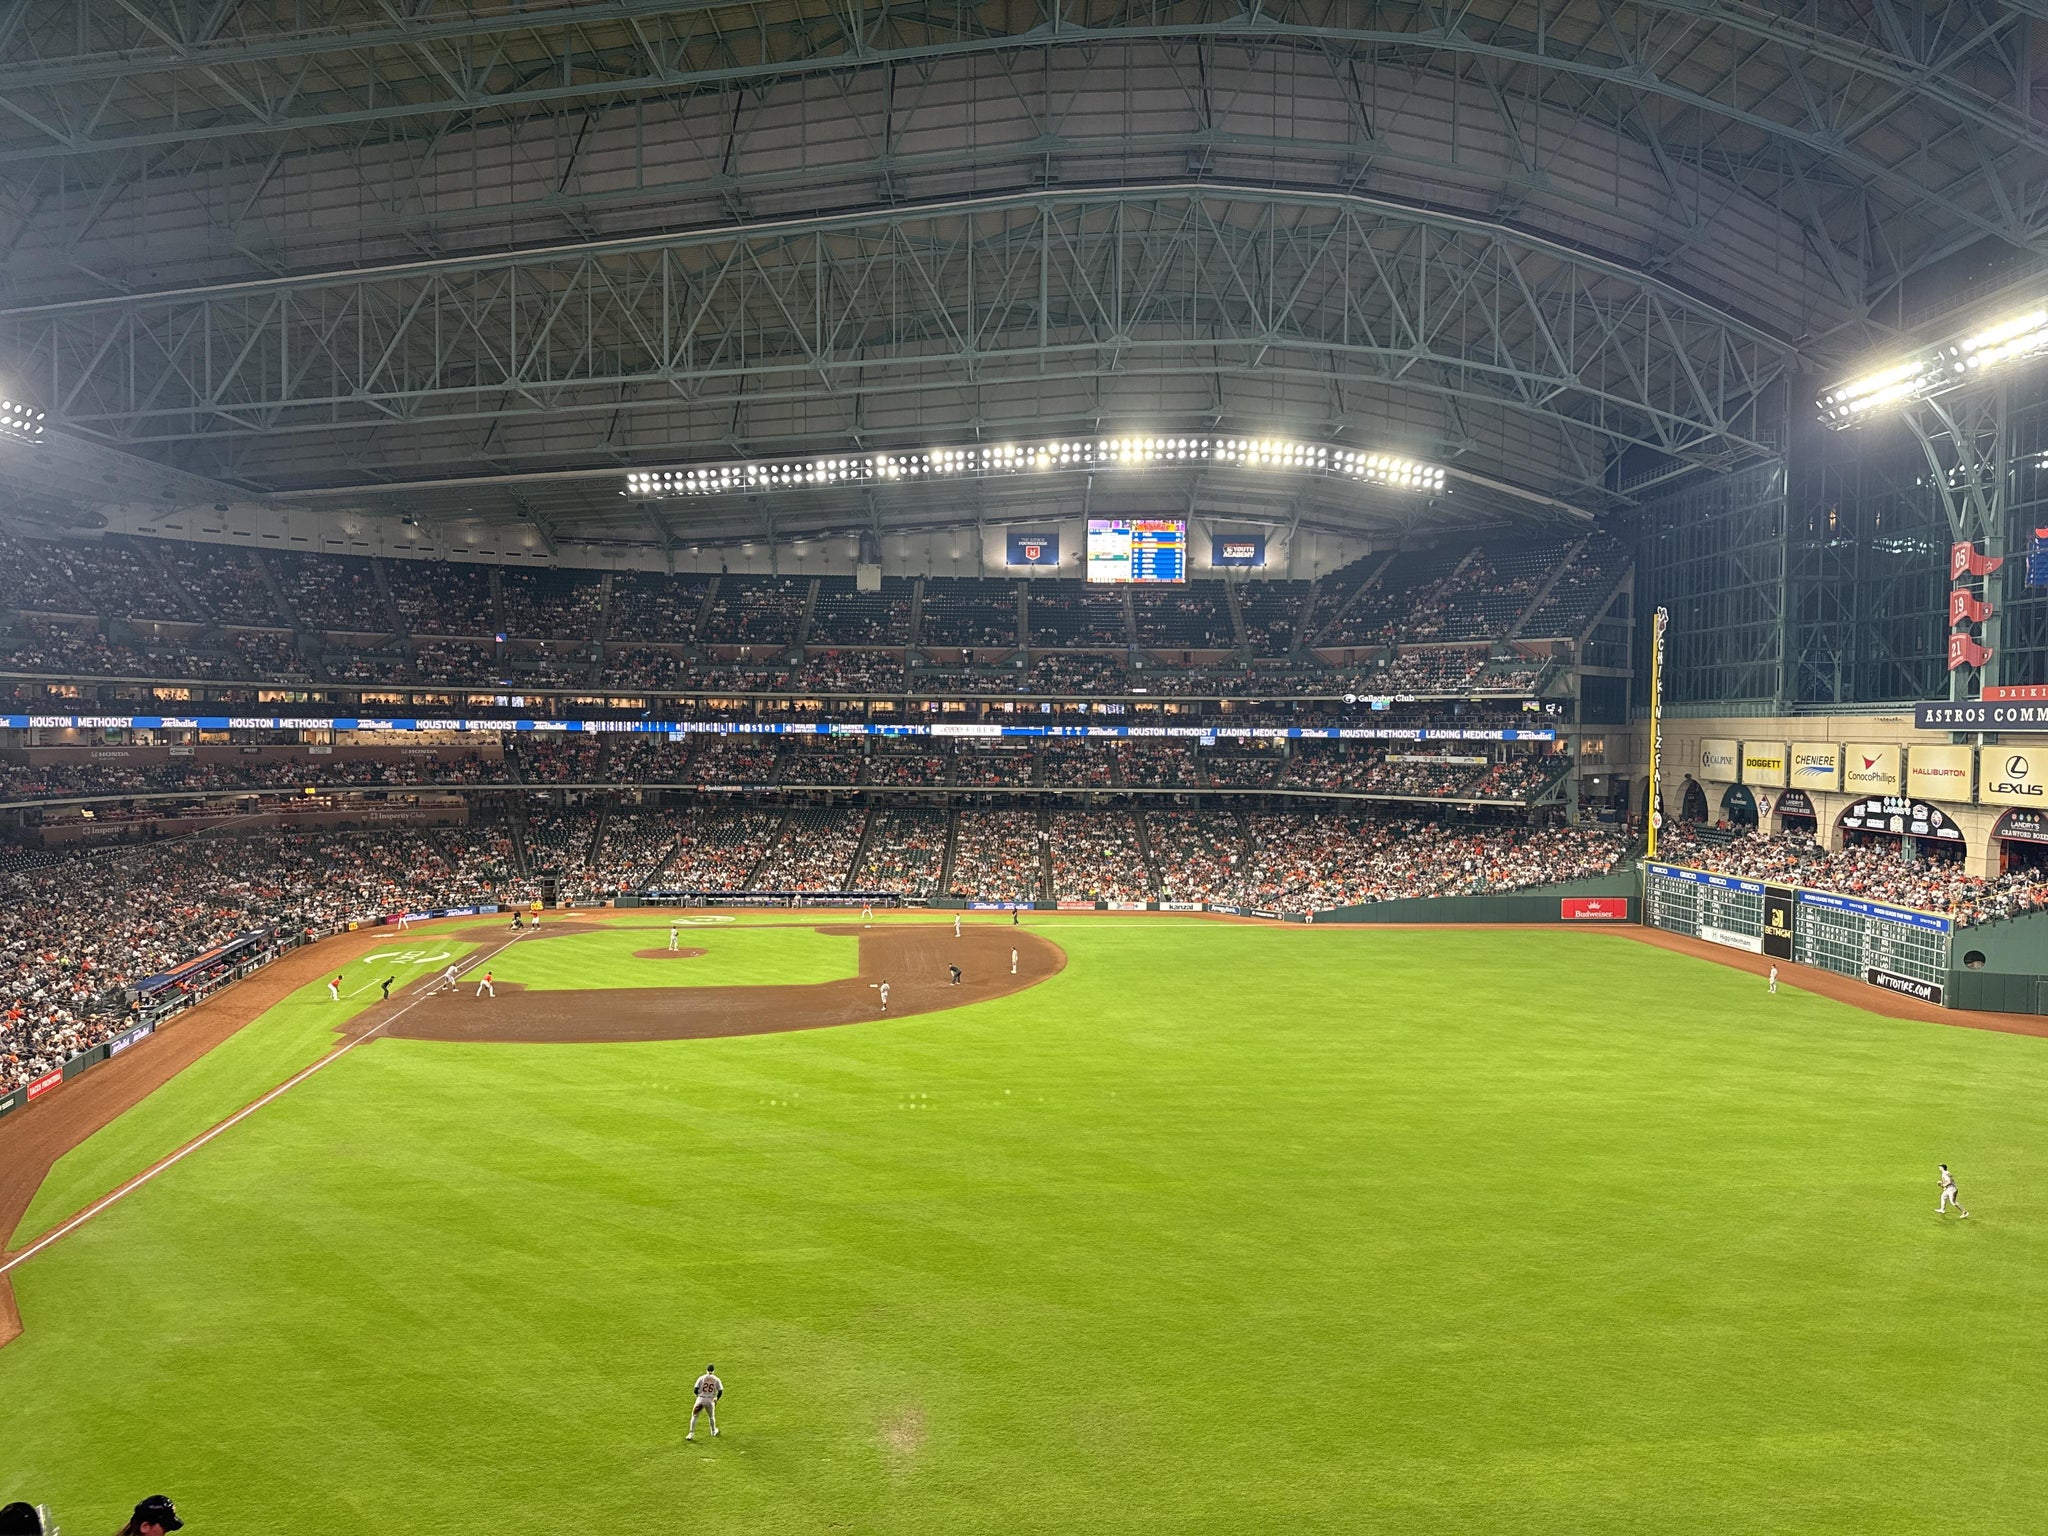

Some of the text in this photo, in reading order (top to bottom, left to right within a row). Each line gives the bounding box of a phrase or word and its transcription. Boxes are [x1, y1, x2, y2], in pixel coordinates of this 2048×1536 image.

[1955, 549, 1966, 568] 05
[1955, 596, 1964, 615] 19
[1951, 641, 1961, 657] 21
[1358, 694, 1415, 703] Gallagher Club
[1925, 708, 1985, 722] ASTROS
[29, 717, 133, 728] HOUSTON METHODIST
[229, 718, 334, 729] HOUSTON METHODIST
[416, 720, 517, 730] HOUSTON METHODIST
[1128, 728, 1289, 737] HOUSTON METHODIST LEADING MEDICINE
[1340, 729, 1503, 740] HOUSTON METHODIST LEADING MEDICINE
[1517, 731, 1552, 740] Methodist
[1710, 756, 1733, 766] CALPINE
[1746, 758, 1781, 769] DOGGETT
[1795, 754, 1835, 766] CHENIERE
[1848, 770, 1896, 784] ConocoPhillips
[1912, 768, 1966, 777] HALLIBURTON
[1989, 782, 2044, 796] LEXUS
[2010, 821, 2040, 830] LANDRY'S
[2001, 829, 2032, 838] CRAWFORD
[1652, 866, 1668, 874] GEICO
[1680, 871, 1697, 880] GEICO
[1708, 876, 1727, 886] GEICO
[1740, 882, 1760, 892] GEICO
[1575, 910, 1614, 918] Budweiser
[1765, 926, 1791, 939] BETMGM
[1877, 973, 1932, 1000] NITTOTIRE.COM
[703, 1383, 714, 1393] 26
